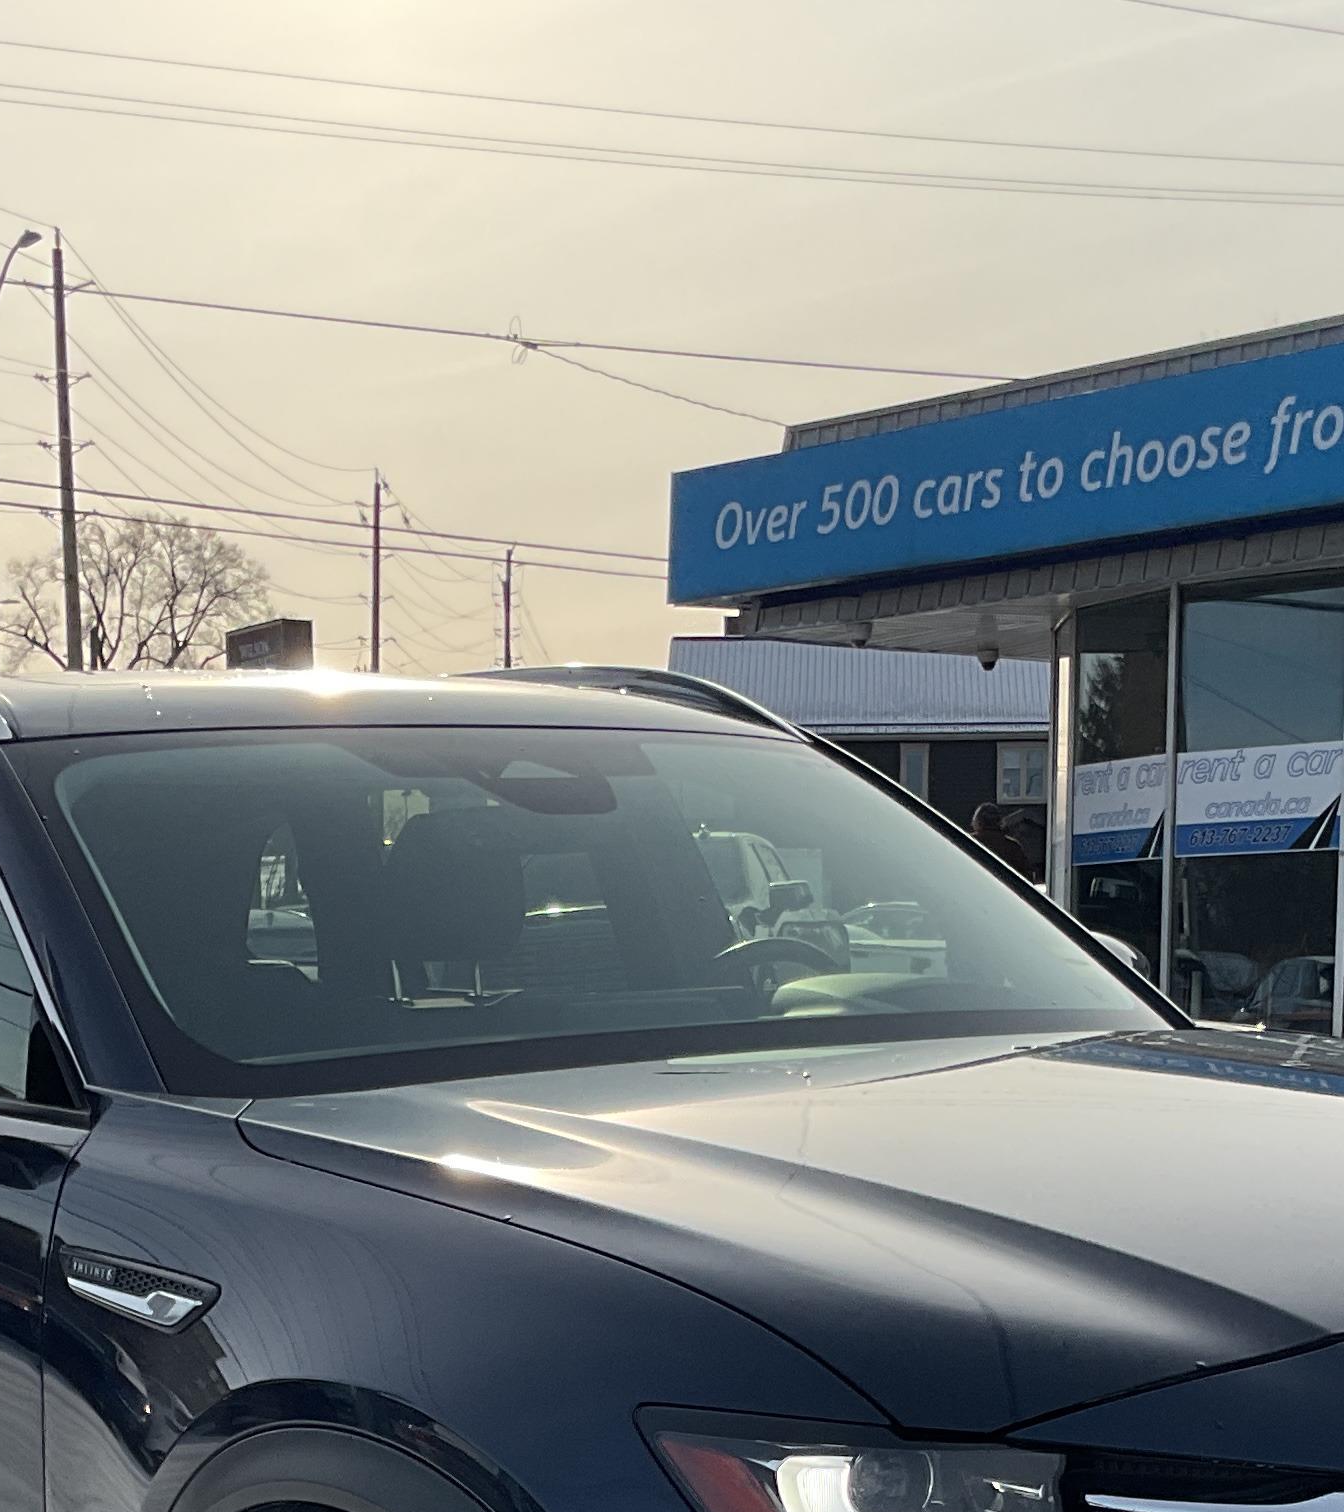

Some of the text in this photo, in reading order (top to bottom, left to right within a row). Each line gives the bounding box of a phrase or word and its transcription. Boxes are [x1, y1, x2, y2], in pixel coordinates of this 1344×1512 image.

[714, 498, 808, 551] Over
[817, 475, 899, 534] 500
[913, 468, 1003, 518] cars
[1018, 450, 1064, 502] to
[1079, 418, 1252, 491] choose
[1117, 766, 1131, 791] a
[1178, 749, 1343, 785] rent a car
[1206, 791, 1312, 820] canada.ca
[1189, 823, 1294, 848] 613-767-2237
